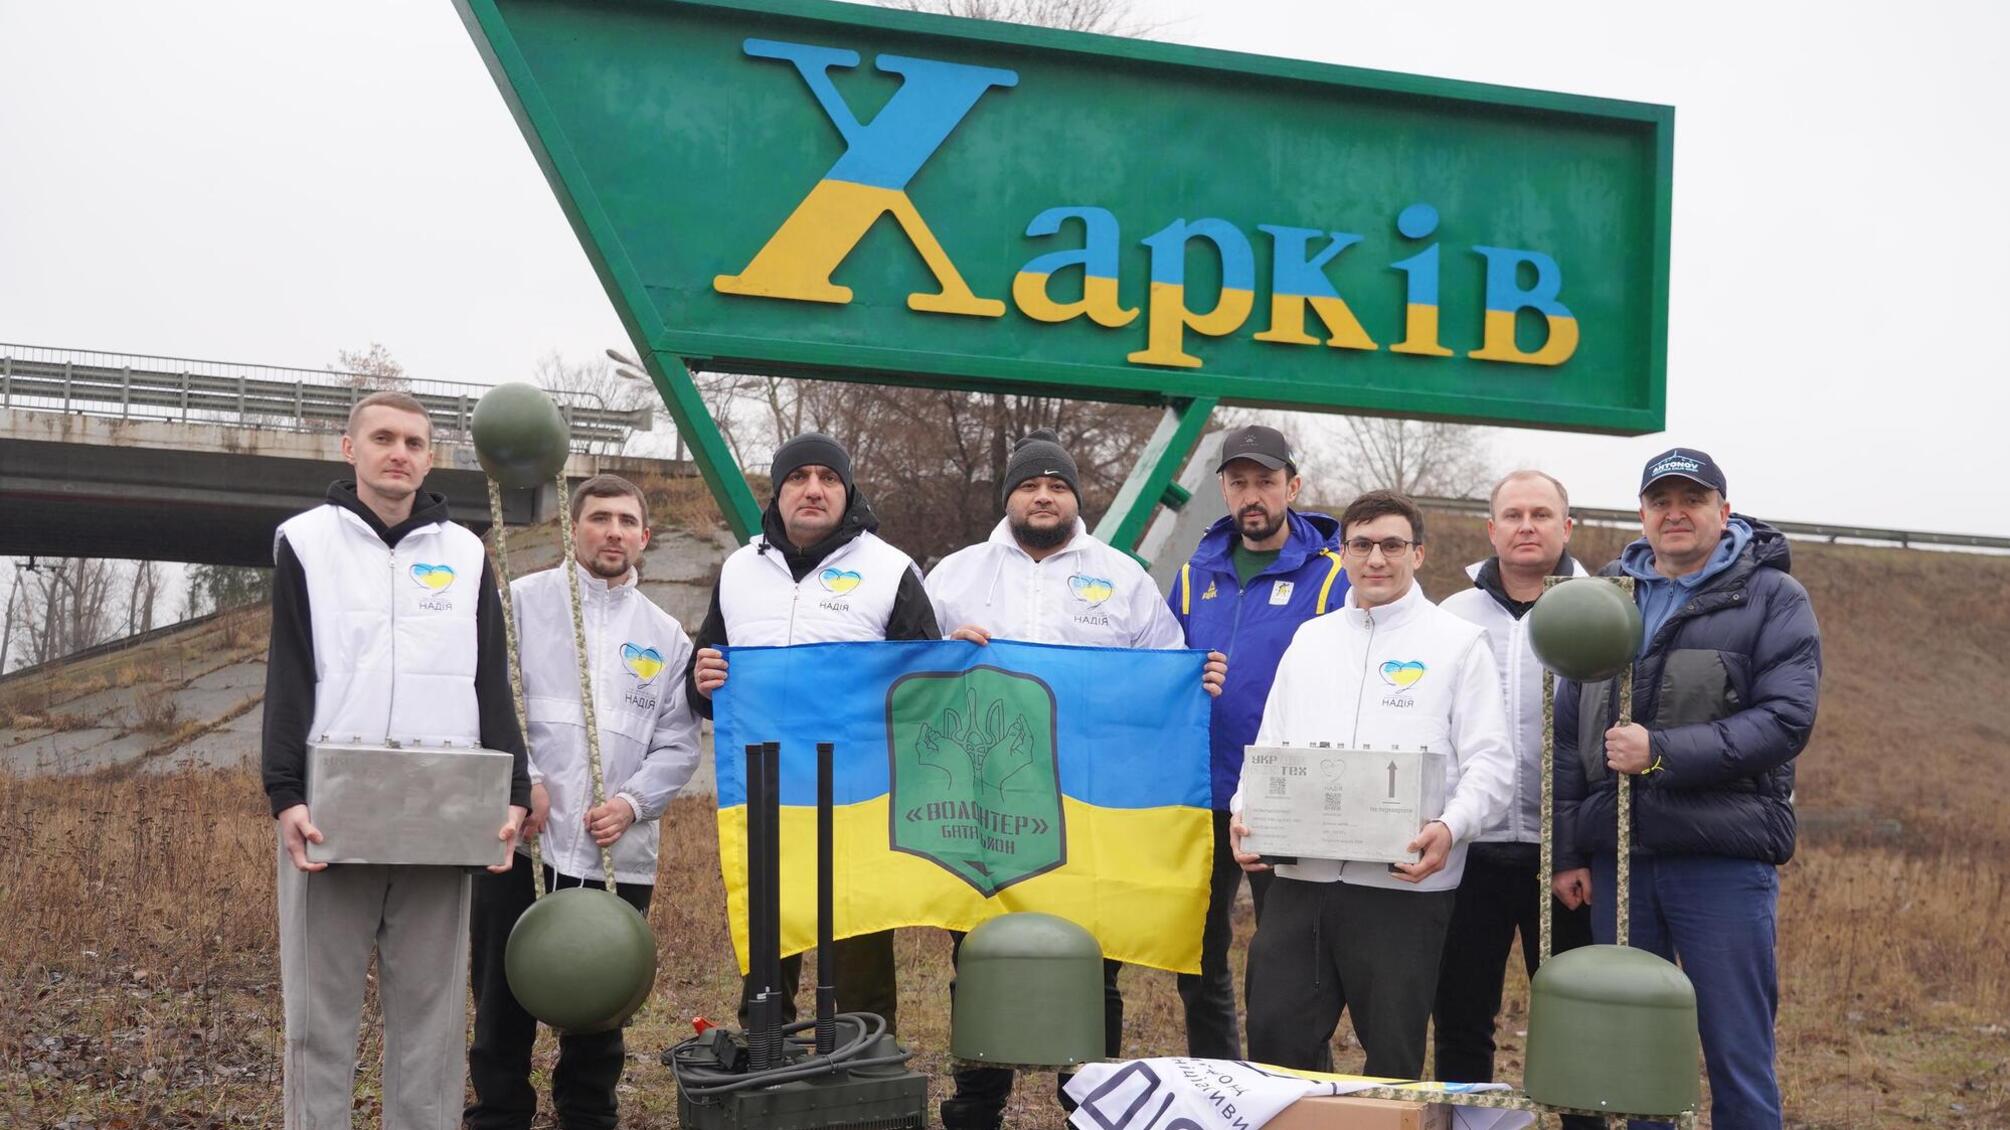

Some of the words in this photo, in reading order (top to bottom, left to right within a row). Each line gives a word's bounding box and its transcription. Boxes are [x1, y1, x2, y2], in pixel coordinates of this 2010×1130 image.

[713, 37, 1579, 368] Харків
[1652, 461, 1699, 474] ANTONOV
[419, 602, 453, 611] НАДІЯ
[819, 602, 849, 611] НАДІЯ
[1073, 615, 1109, 626] НАДІЯ
[624, 693, 656, 710] НАДІЯ
[1381, 699, 1415, 709] НАДІЯ
[942, 824, 1015, 854] БАТАЬЙОН
